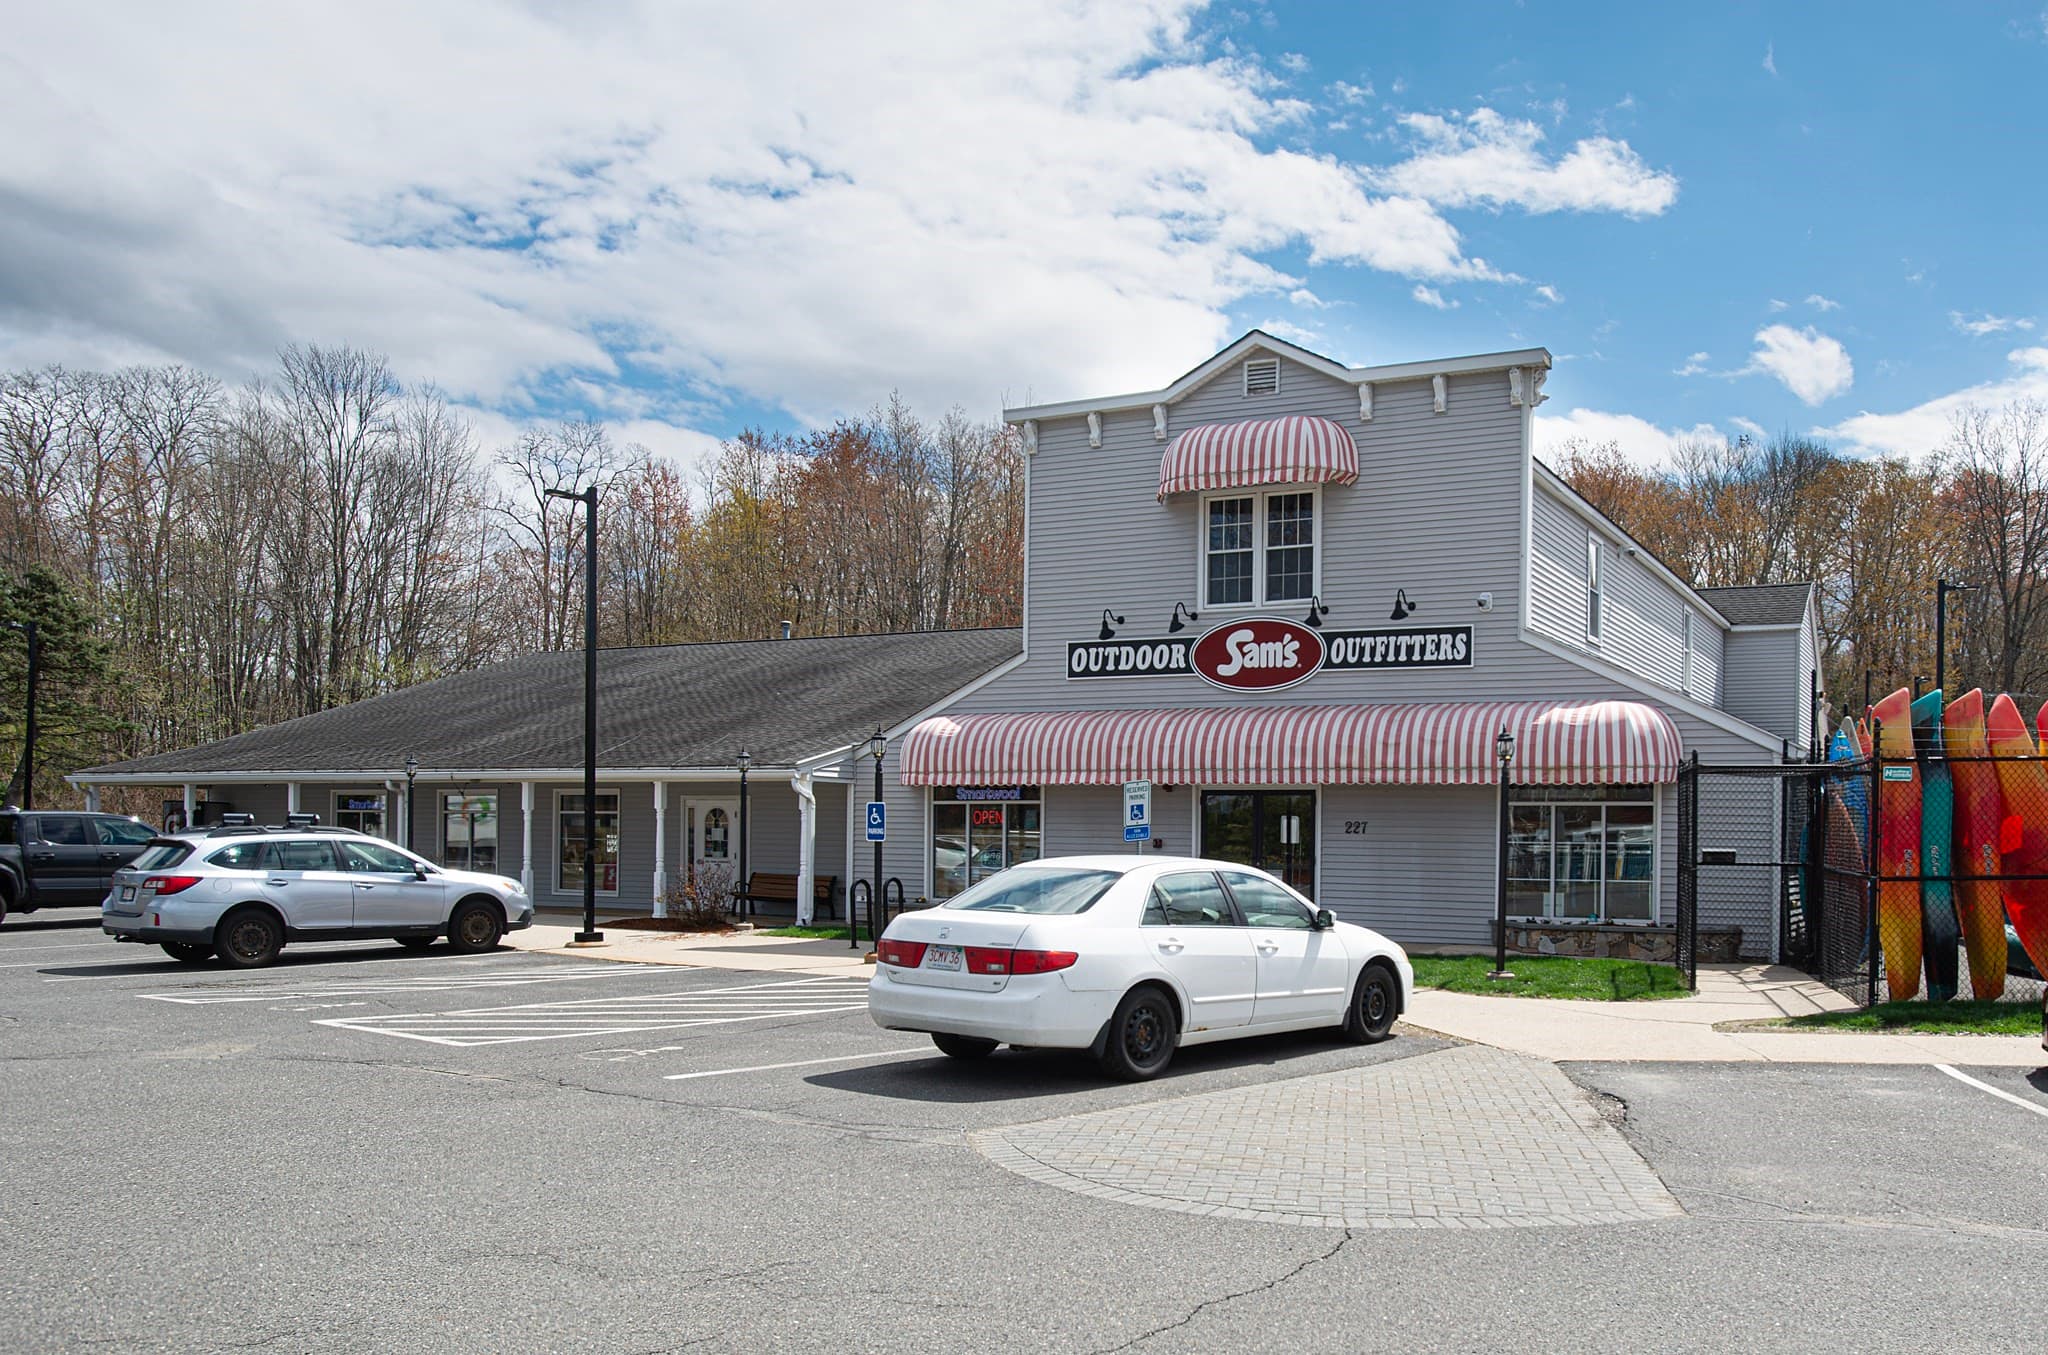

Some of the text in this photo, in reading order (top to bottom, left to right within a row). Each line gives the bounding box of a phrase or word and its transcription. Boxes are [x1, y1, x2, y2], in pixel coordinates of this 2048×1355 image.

[1071, 629, 1467, 676] OUTDOOR Sam's OUTFITTERS
[956, 787, 1021, 800] Smartwool
[973, 810, 1004, 825] OPEN
[1345, 821, 1368, 834] 227
[949, 952, 960, 965] 36
